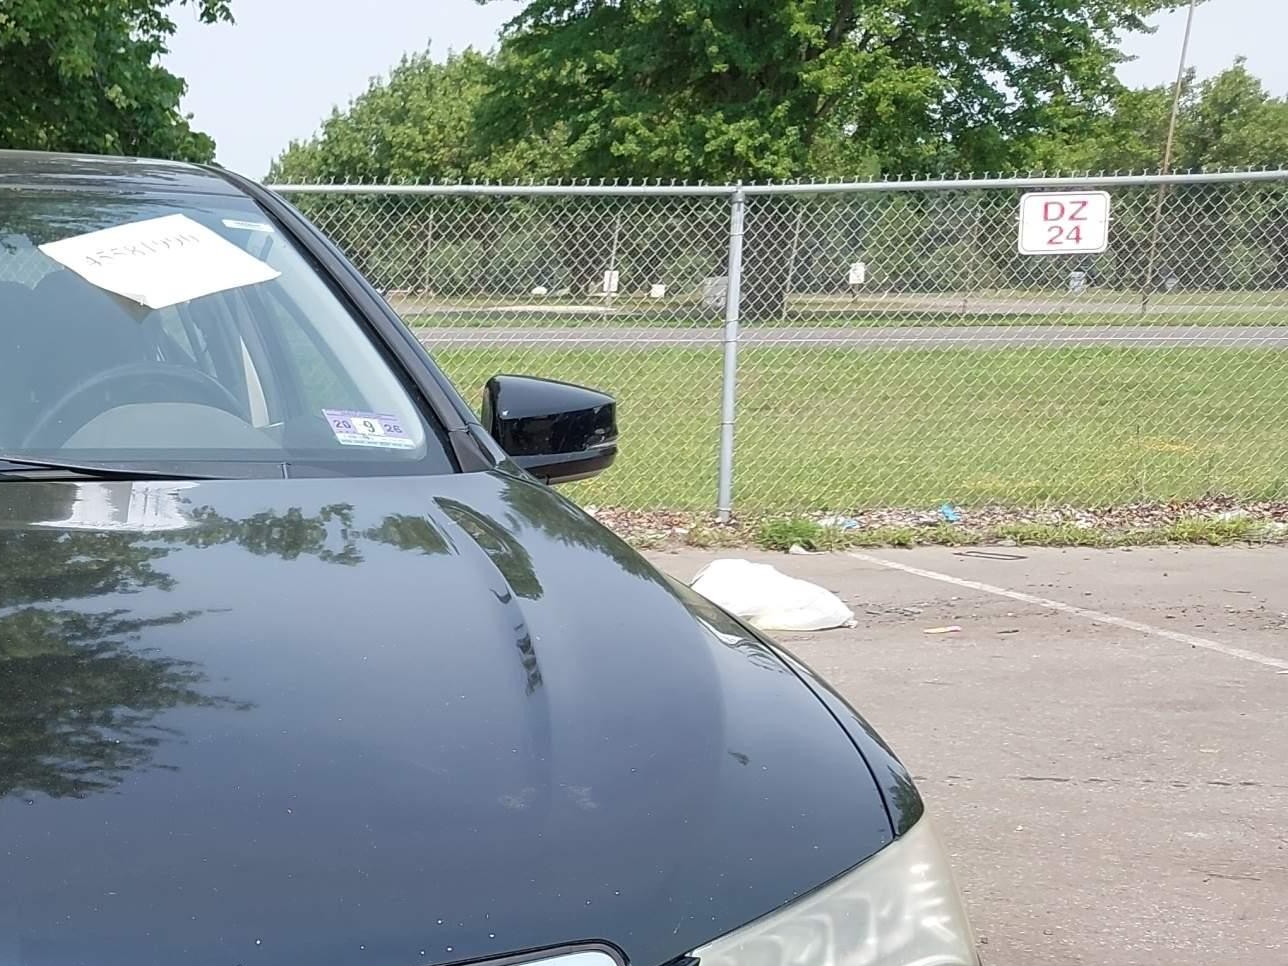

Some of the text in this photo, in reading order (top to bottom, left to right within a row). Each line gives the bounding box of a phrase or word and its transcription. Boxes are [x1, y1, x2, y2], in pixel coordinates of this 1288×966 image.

[1043, 200, 1089, 222] DZ
[1046, 225, 1083, 245] 24
[362, 420, 376, 433] 9
